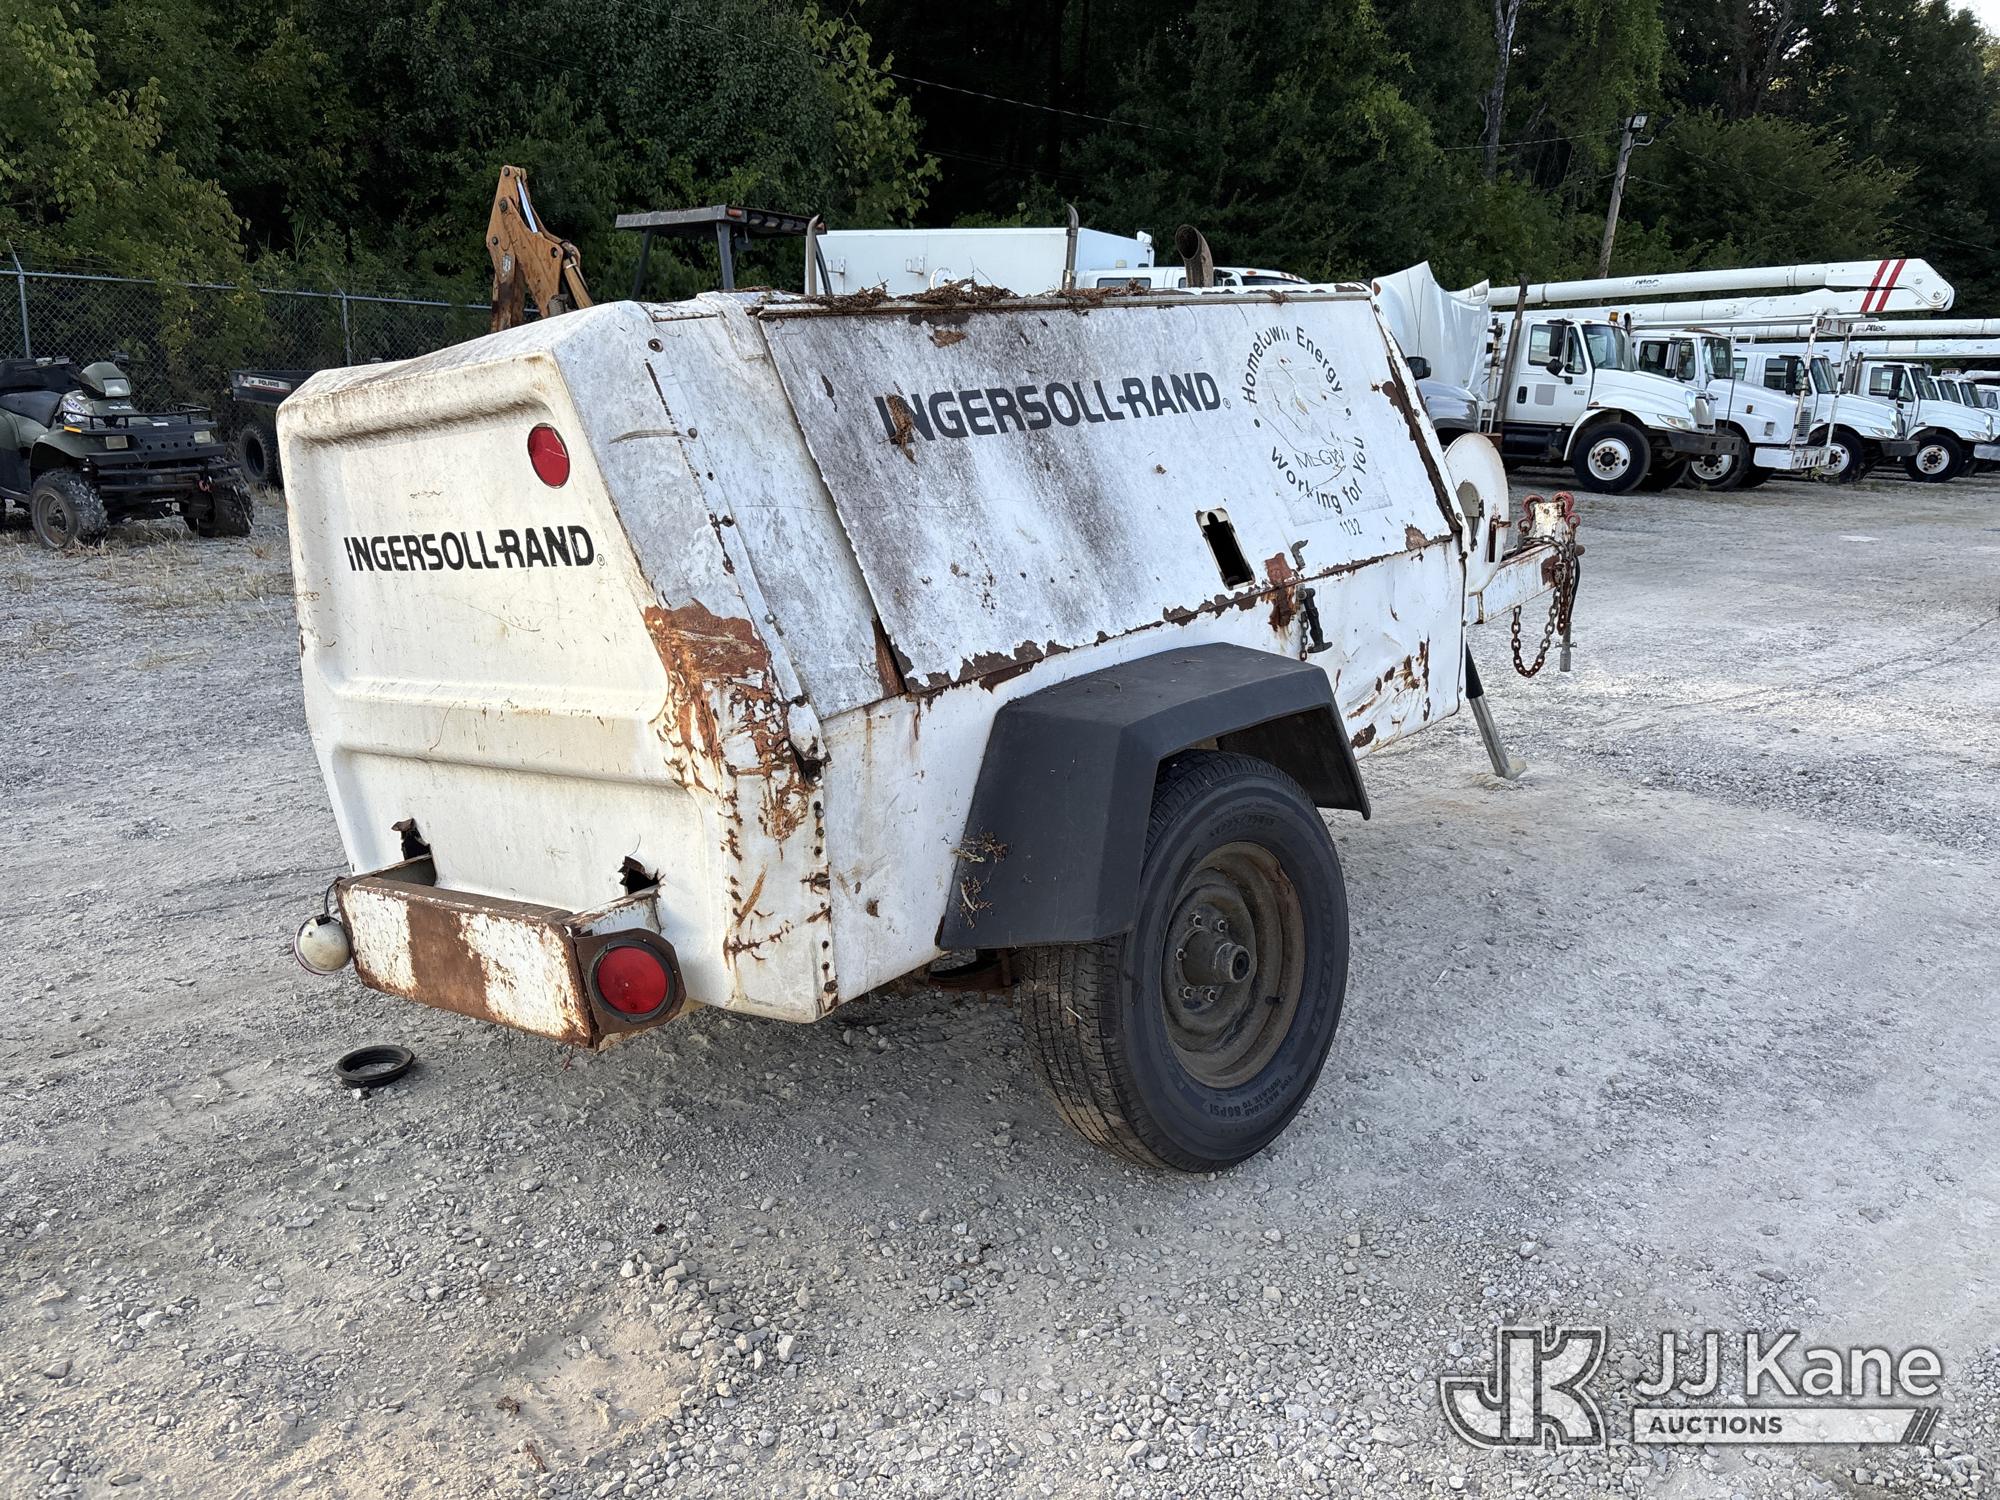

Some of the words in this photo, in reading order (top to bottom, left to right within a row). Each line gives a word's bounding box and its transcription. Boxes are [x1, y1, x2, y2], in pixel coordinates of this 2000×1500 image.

[1297, 326, 1343, 392] Energy
[874, 372, 1221, 445] INGERSOLL-RAND
[1342, 477, 1362, 505] for
[344, 525, 594, 571] INGERSOLL-RAND
[1340, 518, 1362, 536] 1132
